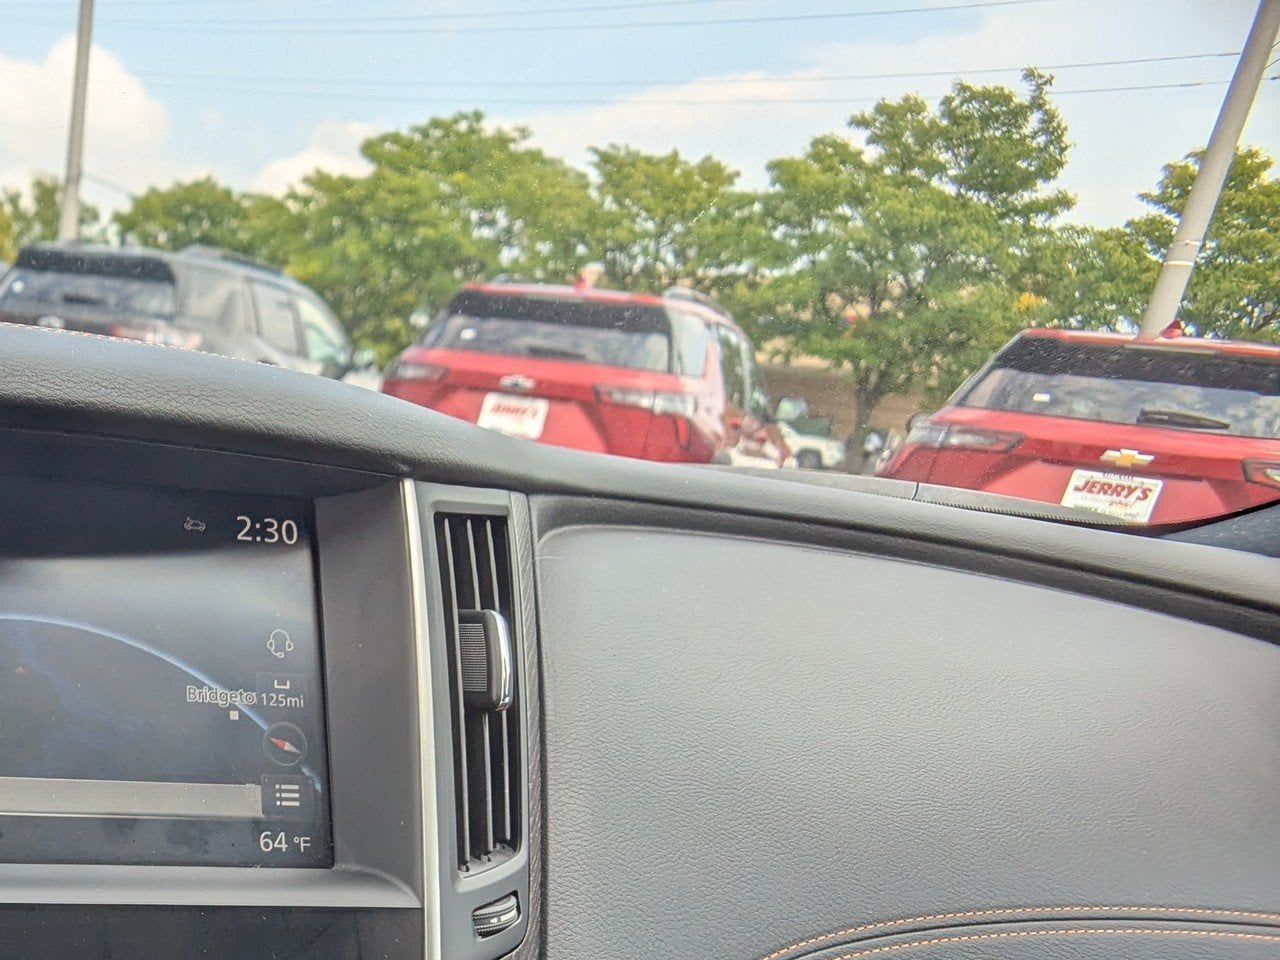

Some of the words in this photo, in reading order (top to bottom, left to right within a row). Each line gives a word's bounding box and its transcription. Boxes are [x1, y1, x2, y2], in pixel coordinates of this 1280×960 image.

[1073, 478, 1153, 502] JERRY'S
[236, 515, 298, 545] 2:30
[261, 693, 305, 708] 125mi
[260, 831, 288, 852] 64
